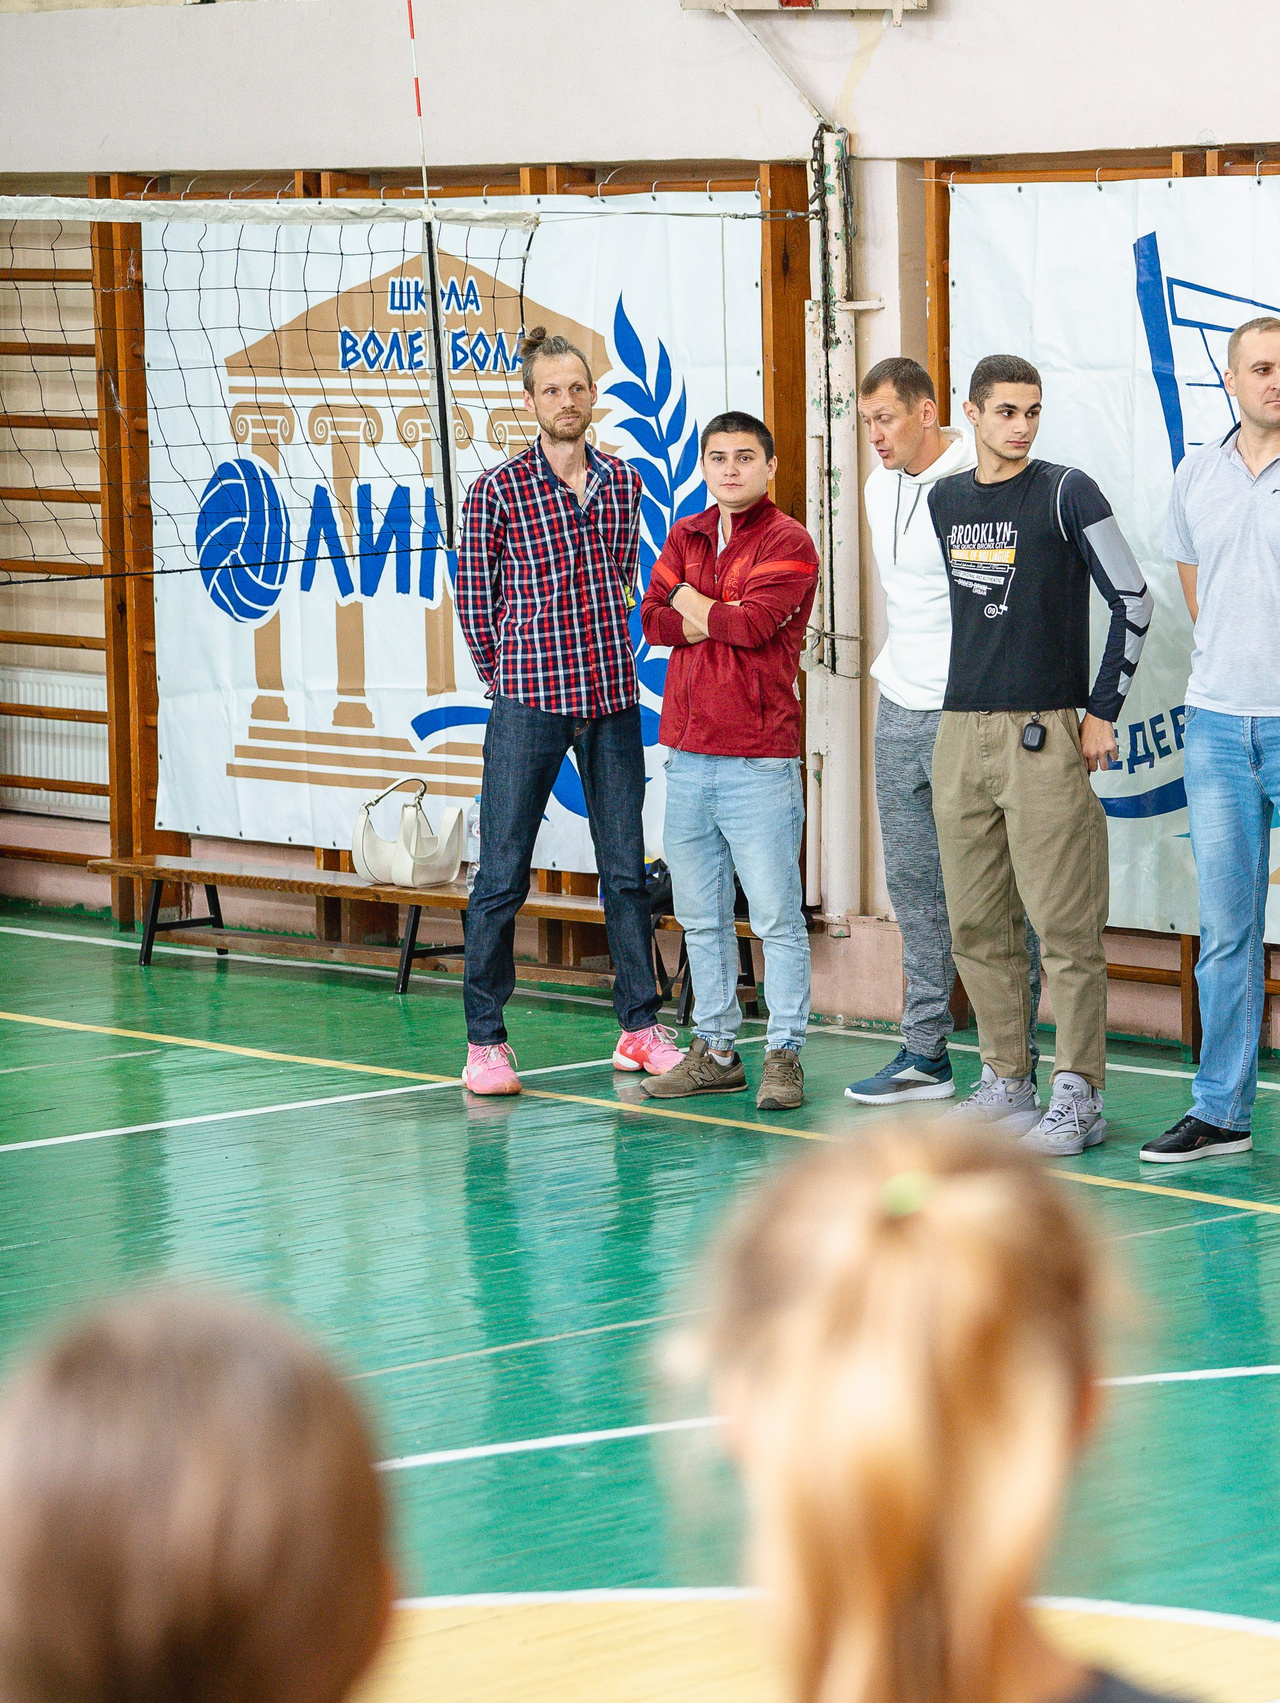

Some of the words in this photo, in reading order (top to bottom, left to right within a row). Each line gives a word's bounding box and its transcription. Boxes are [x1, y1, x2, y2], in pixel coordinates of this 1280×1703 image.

[390, 279, 480, 311] ШКЛА
[340, 330, 524, 371] ВОЛЕБОЛА
[950, 521, 1012, 545] BROOKLYN
